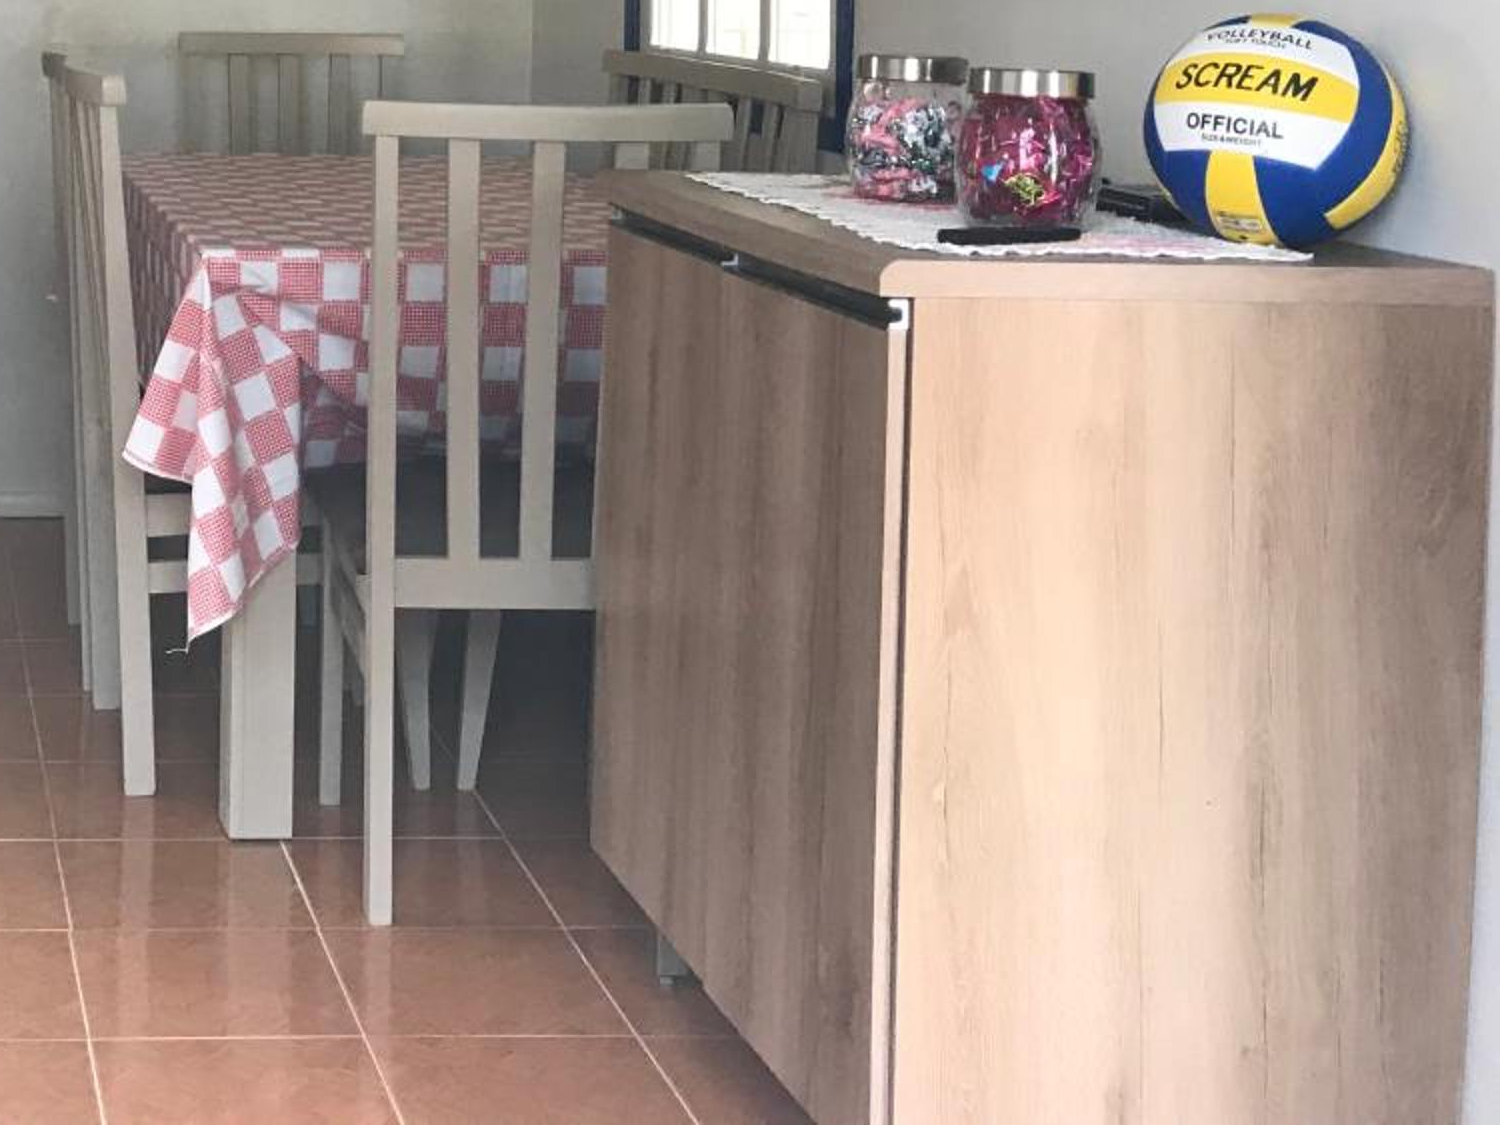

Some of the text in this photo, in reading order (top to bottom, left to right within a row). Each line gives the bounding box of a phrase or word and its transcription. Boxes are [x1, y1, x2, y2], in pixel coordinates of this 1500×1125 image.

[1207, 28, 1313, 50] VOLLEYBALL
[1175, 62, 1319, 102] SCREAM
[1187, 112, 1284, 140] OFFICIAL
